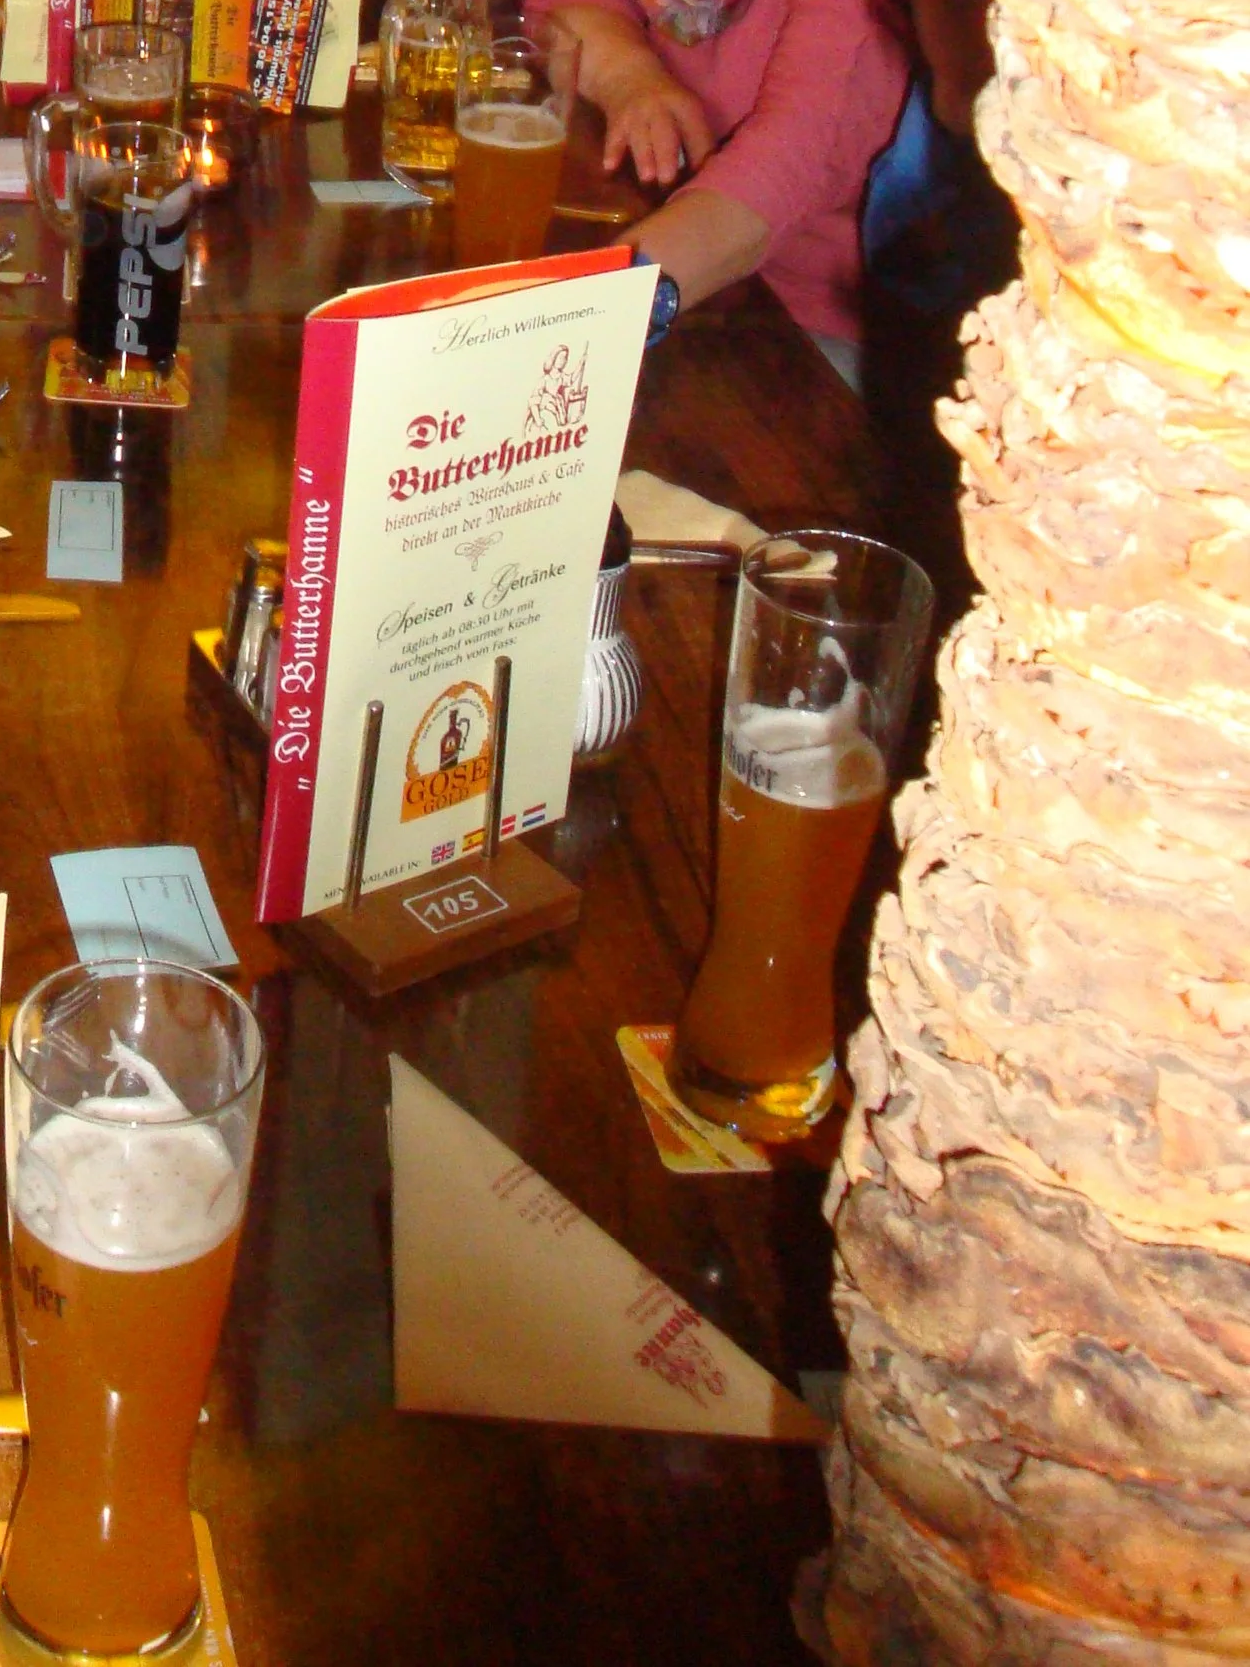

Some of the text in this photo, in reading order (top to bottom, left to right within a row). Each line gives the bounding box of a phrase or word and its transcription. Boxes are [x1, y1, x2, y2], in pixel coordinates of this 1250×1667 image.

[262, 38, 283, 100] Walpurgis
[115, 193, 159, 356] PEPSI
[432, 306, 606, 355] Herzlich Willkommen...
[406, 410, 467, 450] Die
[387, 424, 589, 502] Butterhanne
[385, 496, 462, 533] historisches
[468, 475, 535, 507] Wirtshaus
[538, 470, 551, 485] &
[402, 491, 563, 553] direkt an der Marktkirche
[280, 498, 331, 694] Butterhanne
[376, 563, 566, 646] Speisen & Getränke
[389, 612, 541, 674] durchgehend warmer Küche
[401, 634, 440, 656] täglich
[441, 626, 456, 641] ab
[517, 600, 535, 616] mit
[409, 664, 431, 682] und
[433, 654, 464, 674] frisch
[466, 645, 490, 661] vom
[274, 705, 312, 764] Die
[406, 756, 489, 805] GOSE
[360, 865, 405, 886] VAILABLE
[423, 890, 479, 921] 105
